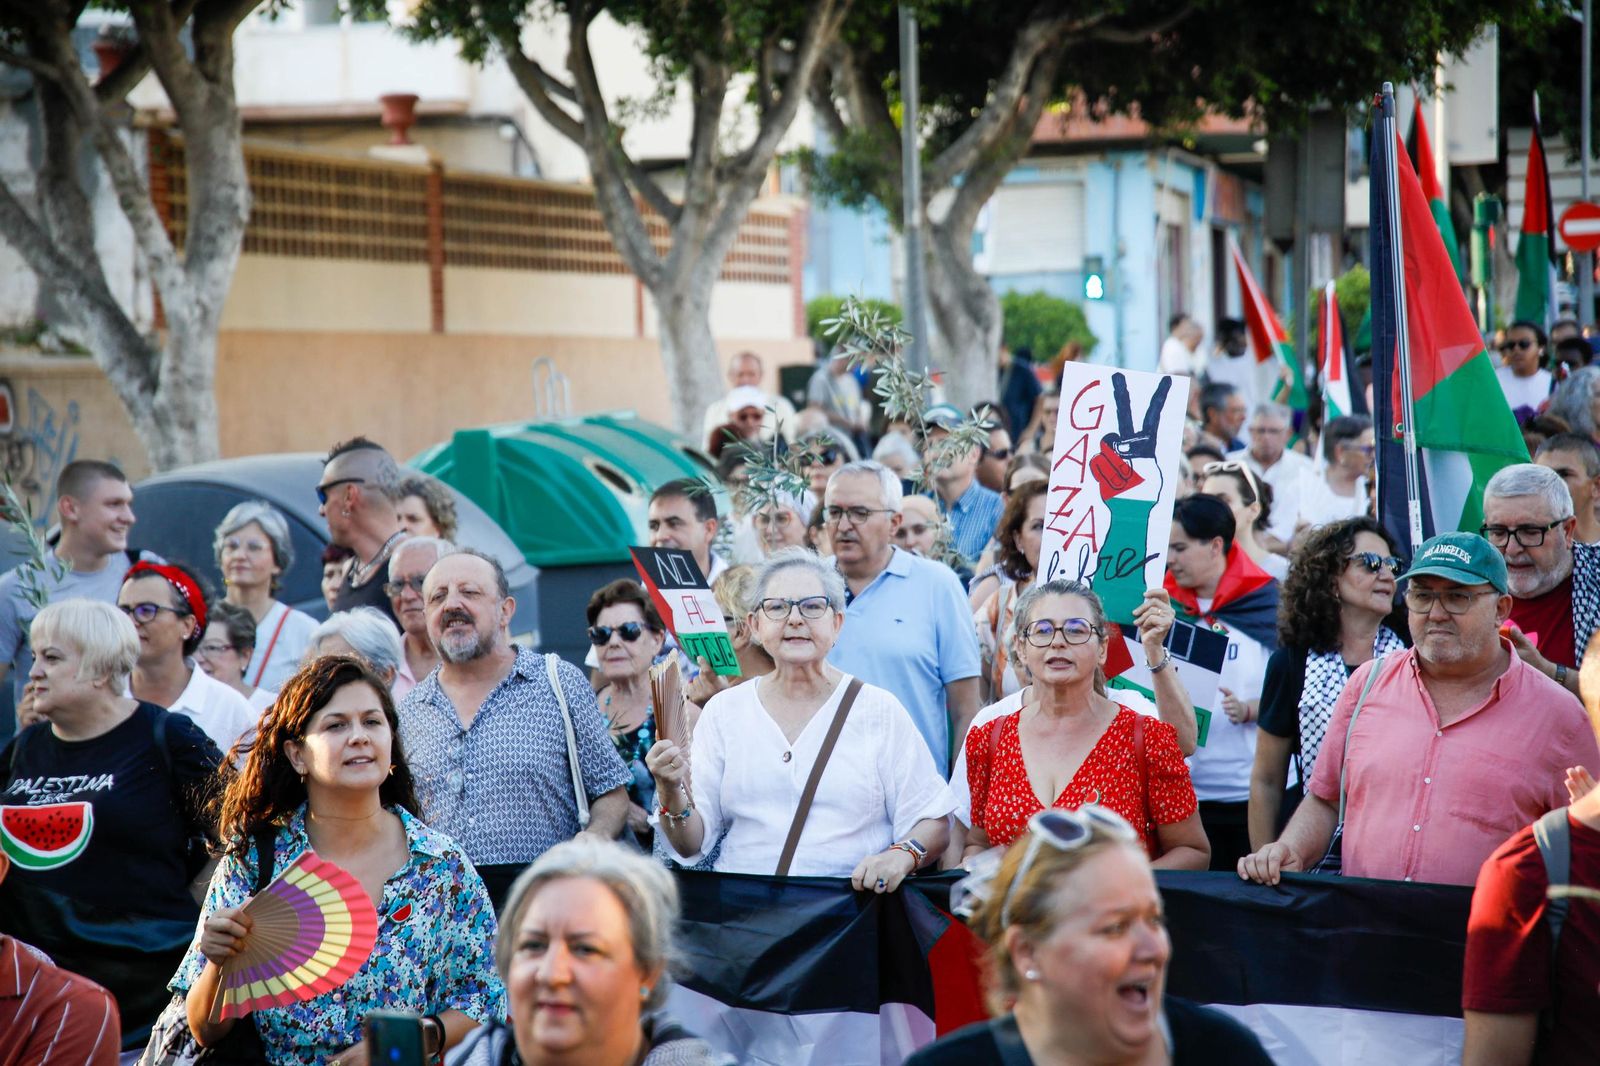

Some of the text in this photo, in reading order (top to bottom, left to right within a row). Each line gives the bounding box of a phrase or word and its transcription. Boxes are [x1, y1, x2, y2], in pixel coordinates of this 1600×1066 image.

[1046, 379, 1105, 554] GAZA
[654, 551, 697, 586] NO
[1047, 542, 1160, 585] lbre
[681, 594, 716, 625] AL
[3, 773, 114, 796] PALESTINA
